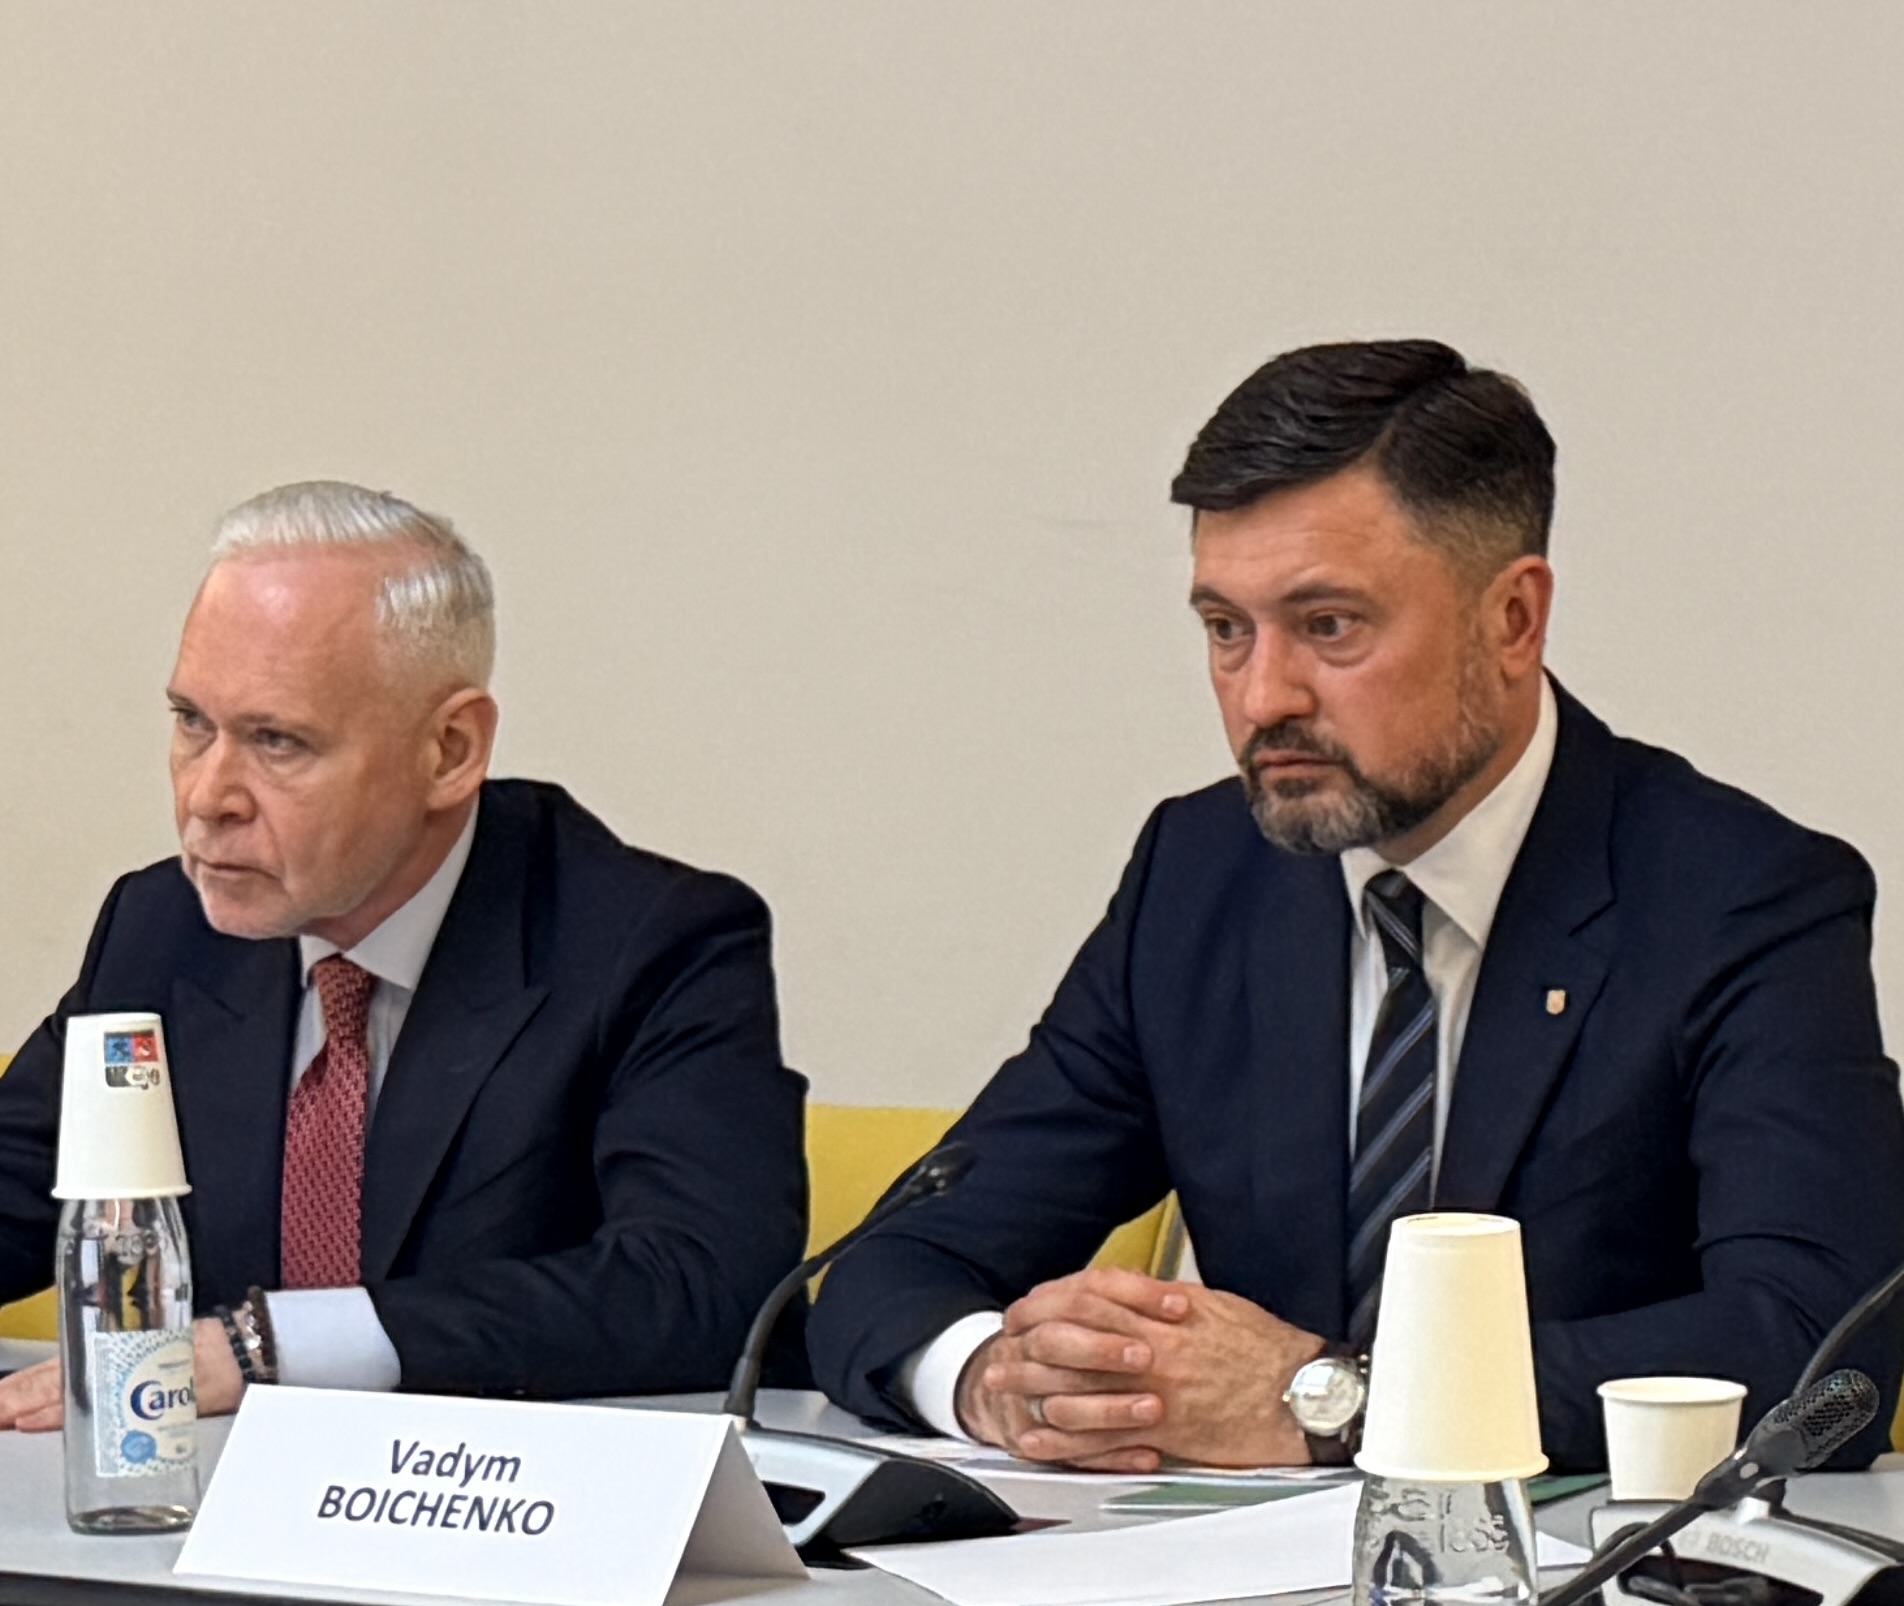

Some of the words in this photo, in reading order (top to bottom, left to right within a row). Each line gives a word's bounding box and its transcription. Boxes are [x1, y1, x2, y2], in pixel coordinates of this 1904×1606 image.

[391, 1439, 521, 1488] Vadym
[317, 1485, 555, 1535] BOICHENKO
[1706, 1532, 1770, 1564] BOSCH
